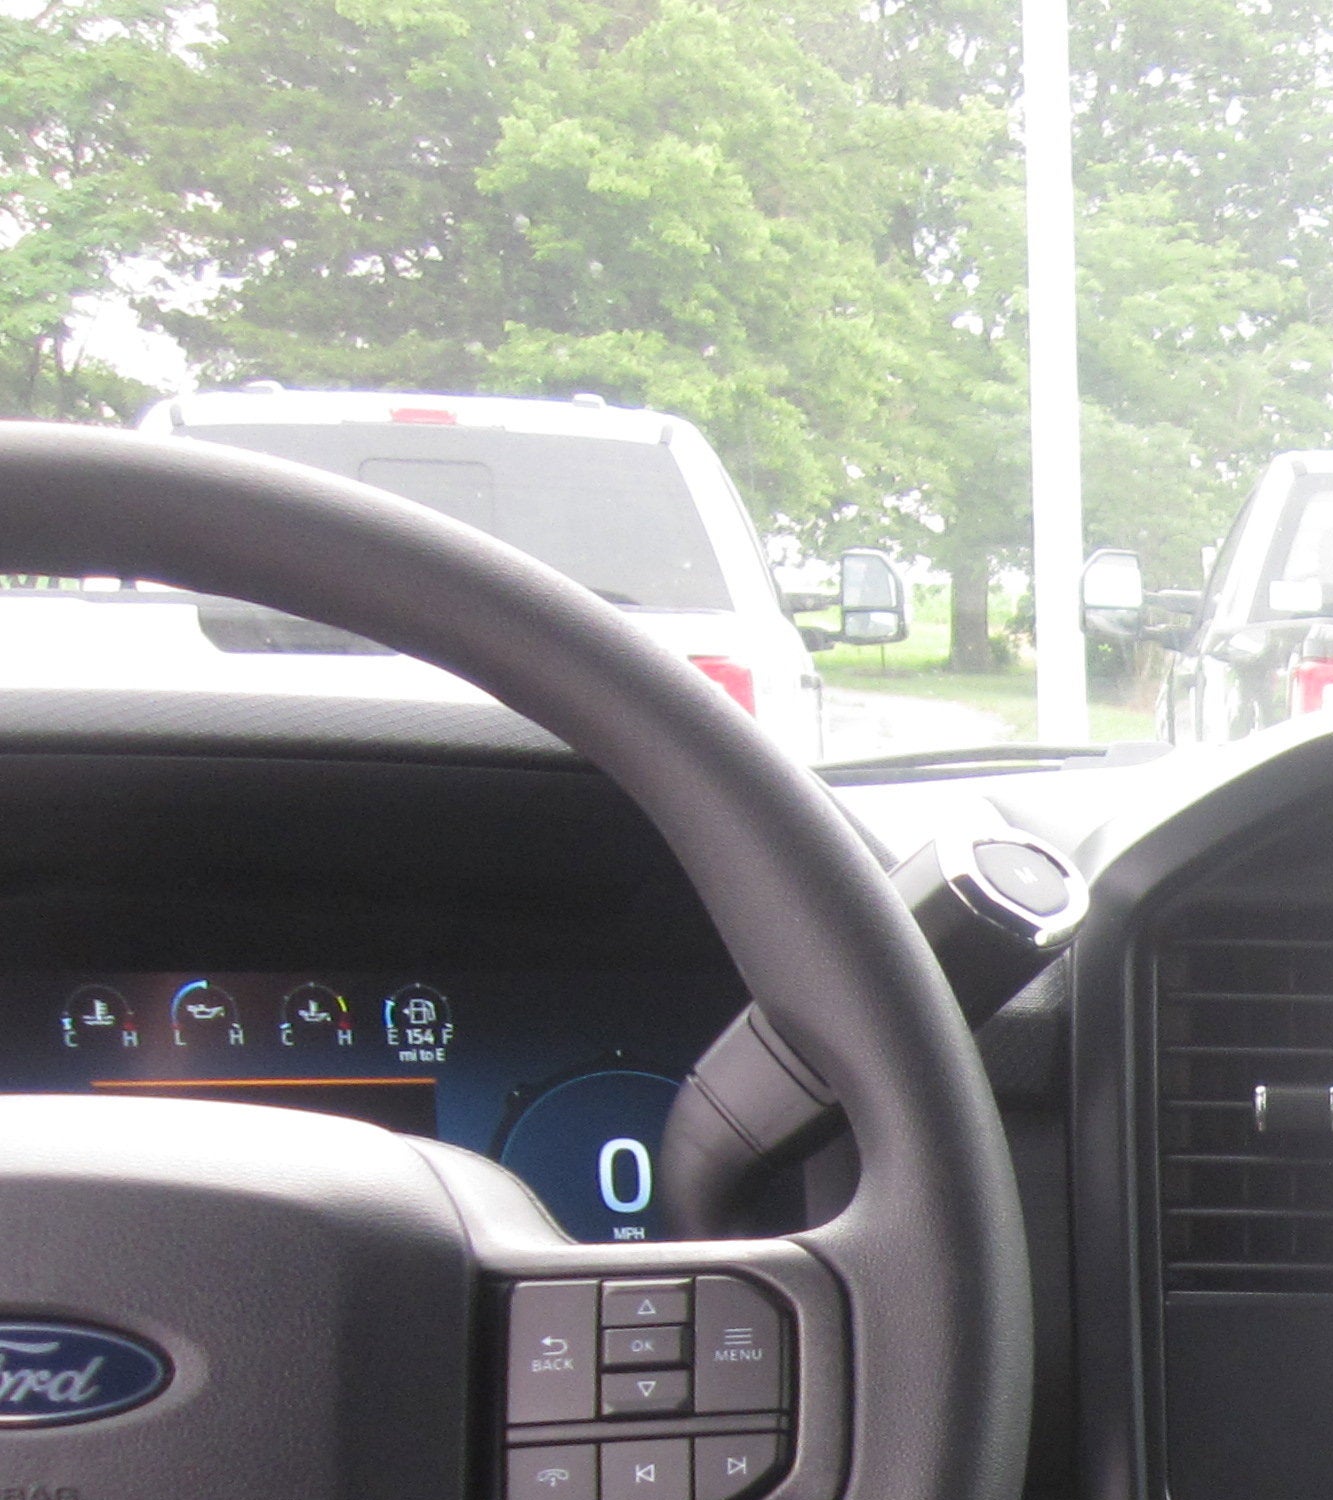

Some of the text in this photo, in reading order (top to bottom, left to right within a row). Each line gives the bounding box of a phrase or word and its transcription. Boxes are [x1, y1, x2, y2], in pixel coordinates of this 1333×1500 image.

[64, 1030, 78, 1047] C
[122, 1031, 137, 1047] H
[175, 1030, 186, 1045] L
[229, 1030, 244, 1045] H
[281, 1030, 293, 1046] C
[337, 1030, 352, 1045] H
[387, 1029, 398, 1045] E
[406, 1029, 434, 1045] 154
[442, 1029, 453, 1045] F
[399, 1049, 446, 1061] mi to E
[599, 1137, 652, 1213] 0
[613, 1227, 645, 1240] MPH
[630, 1340, 655, 1353] OK
[713, 1347, 763, 1363] MENU
[531, 1358, 575, 1373] BACK
